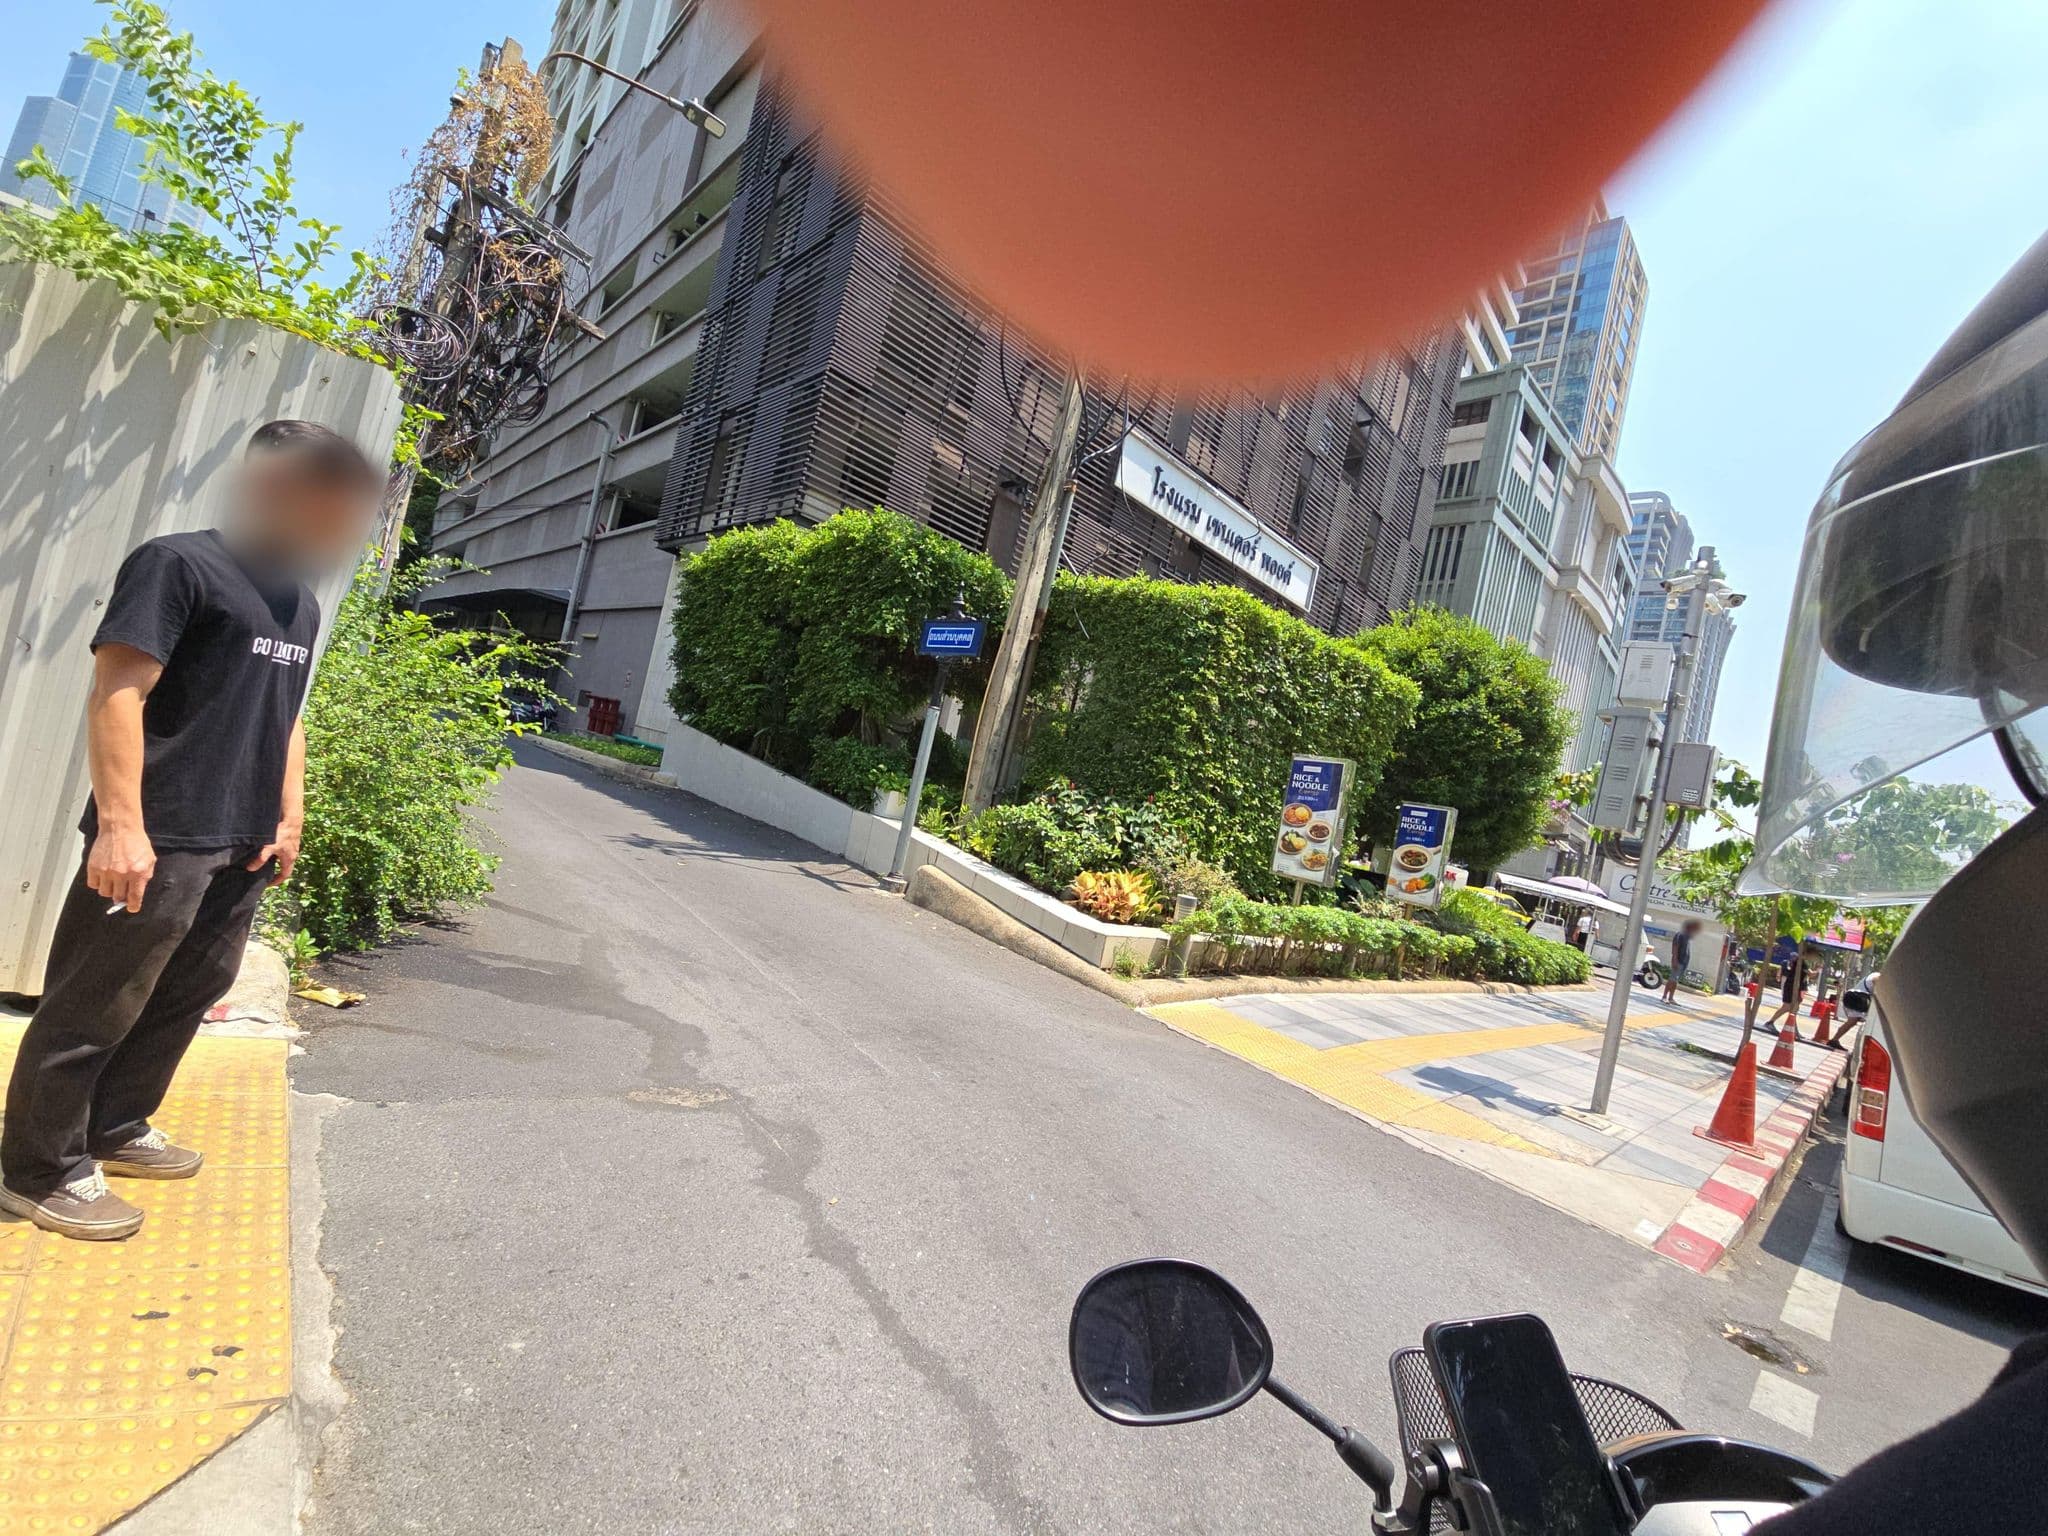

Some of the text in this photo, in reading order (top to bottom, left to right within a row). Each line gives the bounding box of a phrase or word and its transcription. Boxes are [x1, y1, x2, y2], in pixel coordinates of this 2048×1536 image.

[1152, 465, 1201, 524] โรงแรม
[1293, 773, 1314, 782] RICE
[1291, 780, 1329, 792] NOODLE
[1401, 816, 1421, 824] RICE
[1400, 822, 1434, 832] NOODLE
[1620, 874, 1671, 898] Ctre
